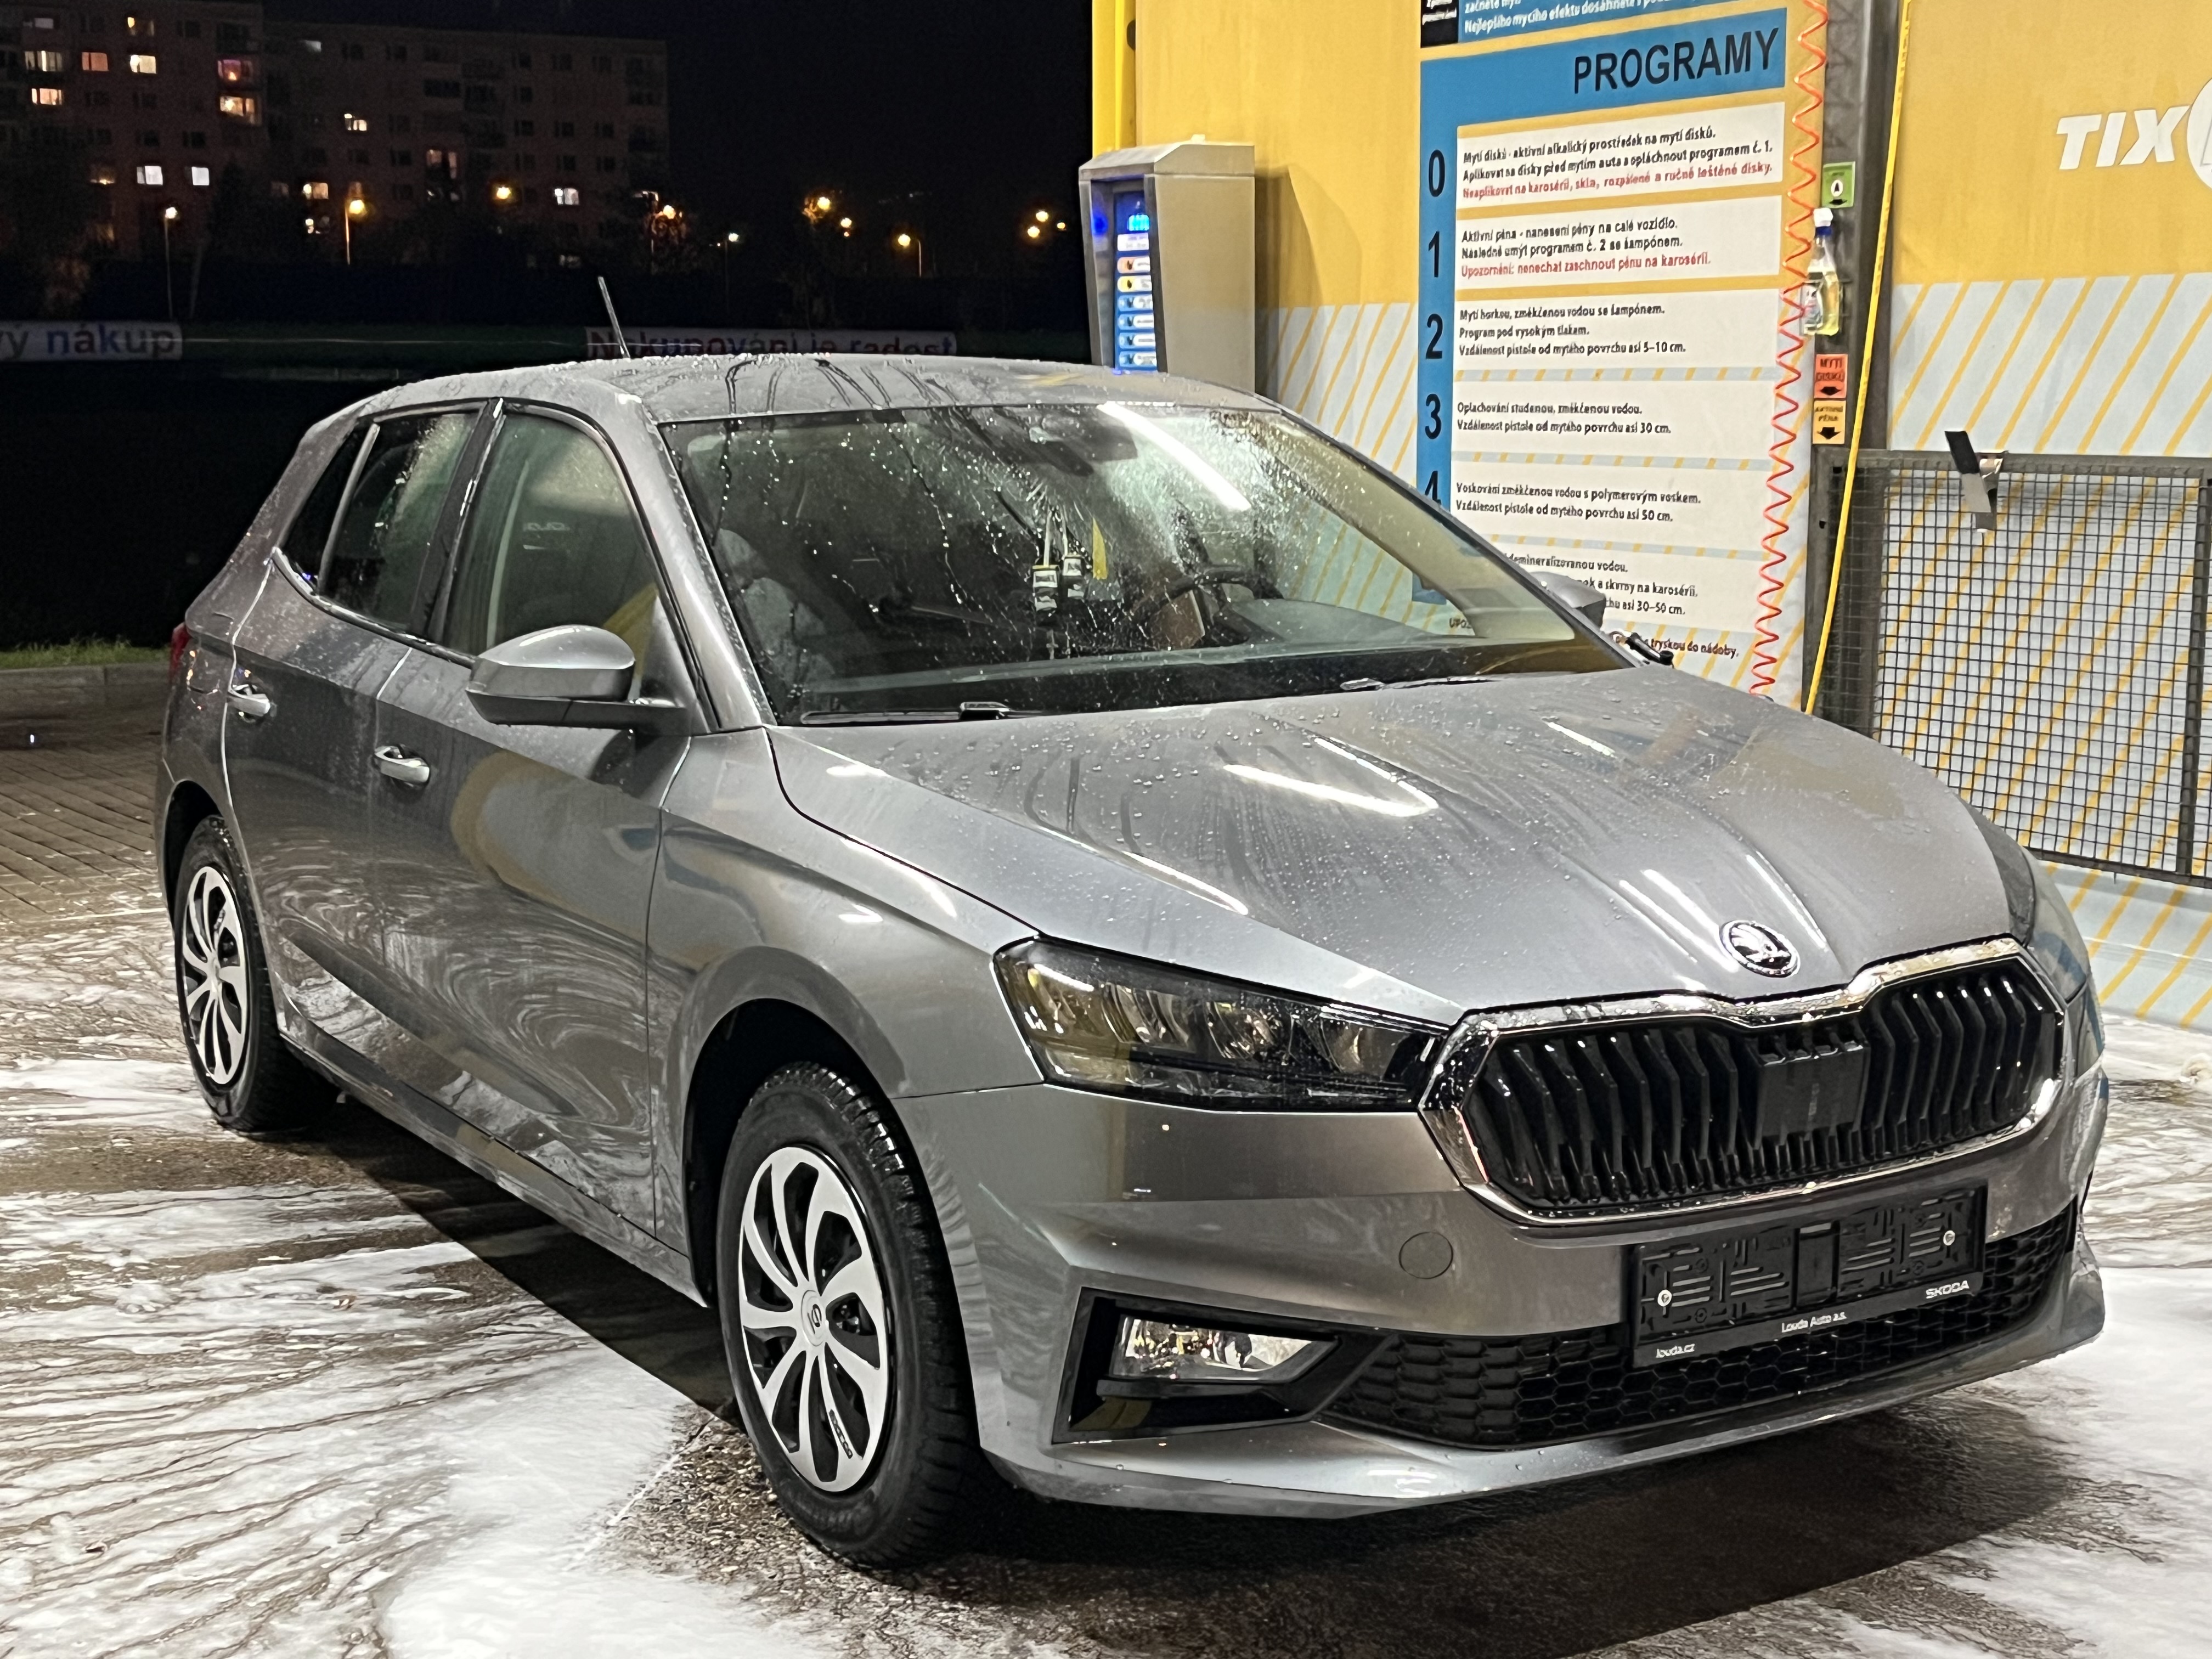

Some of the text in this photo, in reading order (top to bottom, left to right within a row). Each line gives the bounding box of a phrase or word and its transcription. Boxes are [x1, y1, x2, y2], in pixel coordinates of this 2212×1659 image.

[1549, 4, 1580, 20] efektu
[1573, 27, 1779, 94] PROGRAMY
[1513, 144, 1546, 159] aktivní
[1589, 133, 1643, 154] prostředek
[1644, 135, 1657, 146] na
[1660, 128, 1684, 146] mytí
[1428, 149, 1446, 198] 0
[1463, 168, 1504, 184] Aplikovat
[1517, 162, 1542, 177] disky
[1599, 156, 1622, 167] auta
[1623, 157, 1629, 166] a
[1630, 149, 1688, 168] opláchnout
[1689, 144, 1750, 163] programem
[1514, 184, 1527, 195] na
[1604, 170, 1651, 188] rozpálené
[1654, 172, 1662, 182] a
[1664, 165, 1695, 182] ručně
[1697, 162, 1738, 178] leštěné
[1462, 228, 1493, 243] Aktivní
[1495, 228, 1516, 243] pěna
[1526, 224, 1570, 239] nanesení
[1571, 222, 1595, 239] pěny
[1598, 223, 1611, 234] na
[1615, 219, 1634, 233] celé
[1637, 216, 1678, 231] vozidlo.
[1428, 230, 1440, 278] 1
[1462, 245, 1502, 259] Následně
[1530, 242, 1584, 258] programem
[1599, 238, 1606, 251] 2
[1610, 240, 1621, 251] se
[1564, 257, 1616, 273] zaschnout
[1618, 255, 1642, 272] pěnu
[1645, 257, 1658, 268] na
[1460, 308, 1479, 323] Mytí
[1567, 305, 1595, 317] vodou
[1598, 307, 1609, 317] se
[1425, 313, 1443, 360] 2
[1459, 326, 1496, 341] Program
[1497, 325, 1514, 340] pod
[1515, 324, 1555, 340] vysokým
[1459, 343, 1505, 356] Vzdálenost
[1506, 343, 1536, 358] pistole
[1538, 343, 1551, 355] od
[1587, 341, 1627, 357] povrchu
[1628, 341, 1641, 353] asi
[1669, 343, 1686, 353] cm.
[1424, 393, 1442, 439] 3
[1457, 401, 1509, 416] Oplachování
[1511, 402, 1556, 415] studenou,
[1611, 402, 1643, 415] vodou.
[1457, 419, 1503, 431] Vzdálenost
[1504, 419, 1533, 434] pistole
[1536, 419, 1549, 432] od
[1584, 421, 1624, 436] povrchu
[1625, 421, 1638, 433] asi
[1640, 422, 1652, 434] 30
[1456, 482, 1500, 495] Voskování
[1555, 486, 1582, 498] vodou
[1583, 489, 1589, 499] s
[1590, 488, 1658, 505] polymerovým
[1660, 490, 1701, 504] voskem.
[1456, 499, 1503, 512] Vzdálenost
[1504, 502, 1534, 516] pistole
[1536, 503, 1549, 515] od
[1585, 507, 1624, 520] povrchu
[1626, 507, 1640, 520] asi
[1641, 509, 1655, 521] 50
[1656, 512, 1673, 522] cm.
[1597, 580, 1603, 589] a
[1637, 583, 1650, 593] na
[1622, 599, 1635, 611] asi
[1668, 605, 1686, 615] cm.
[1687, 640, 1699, 652] do
